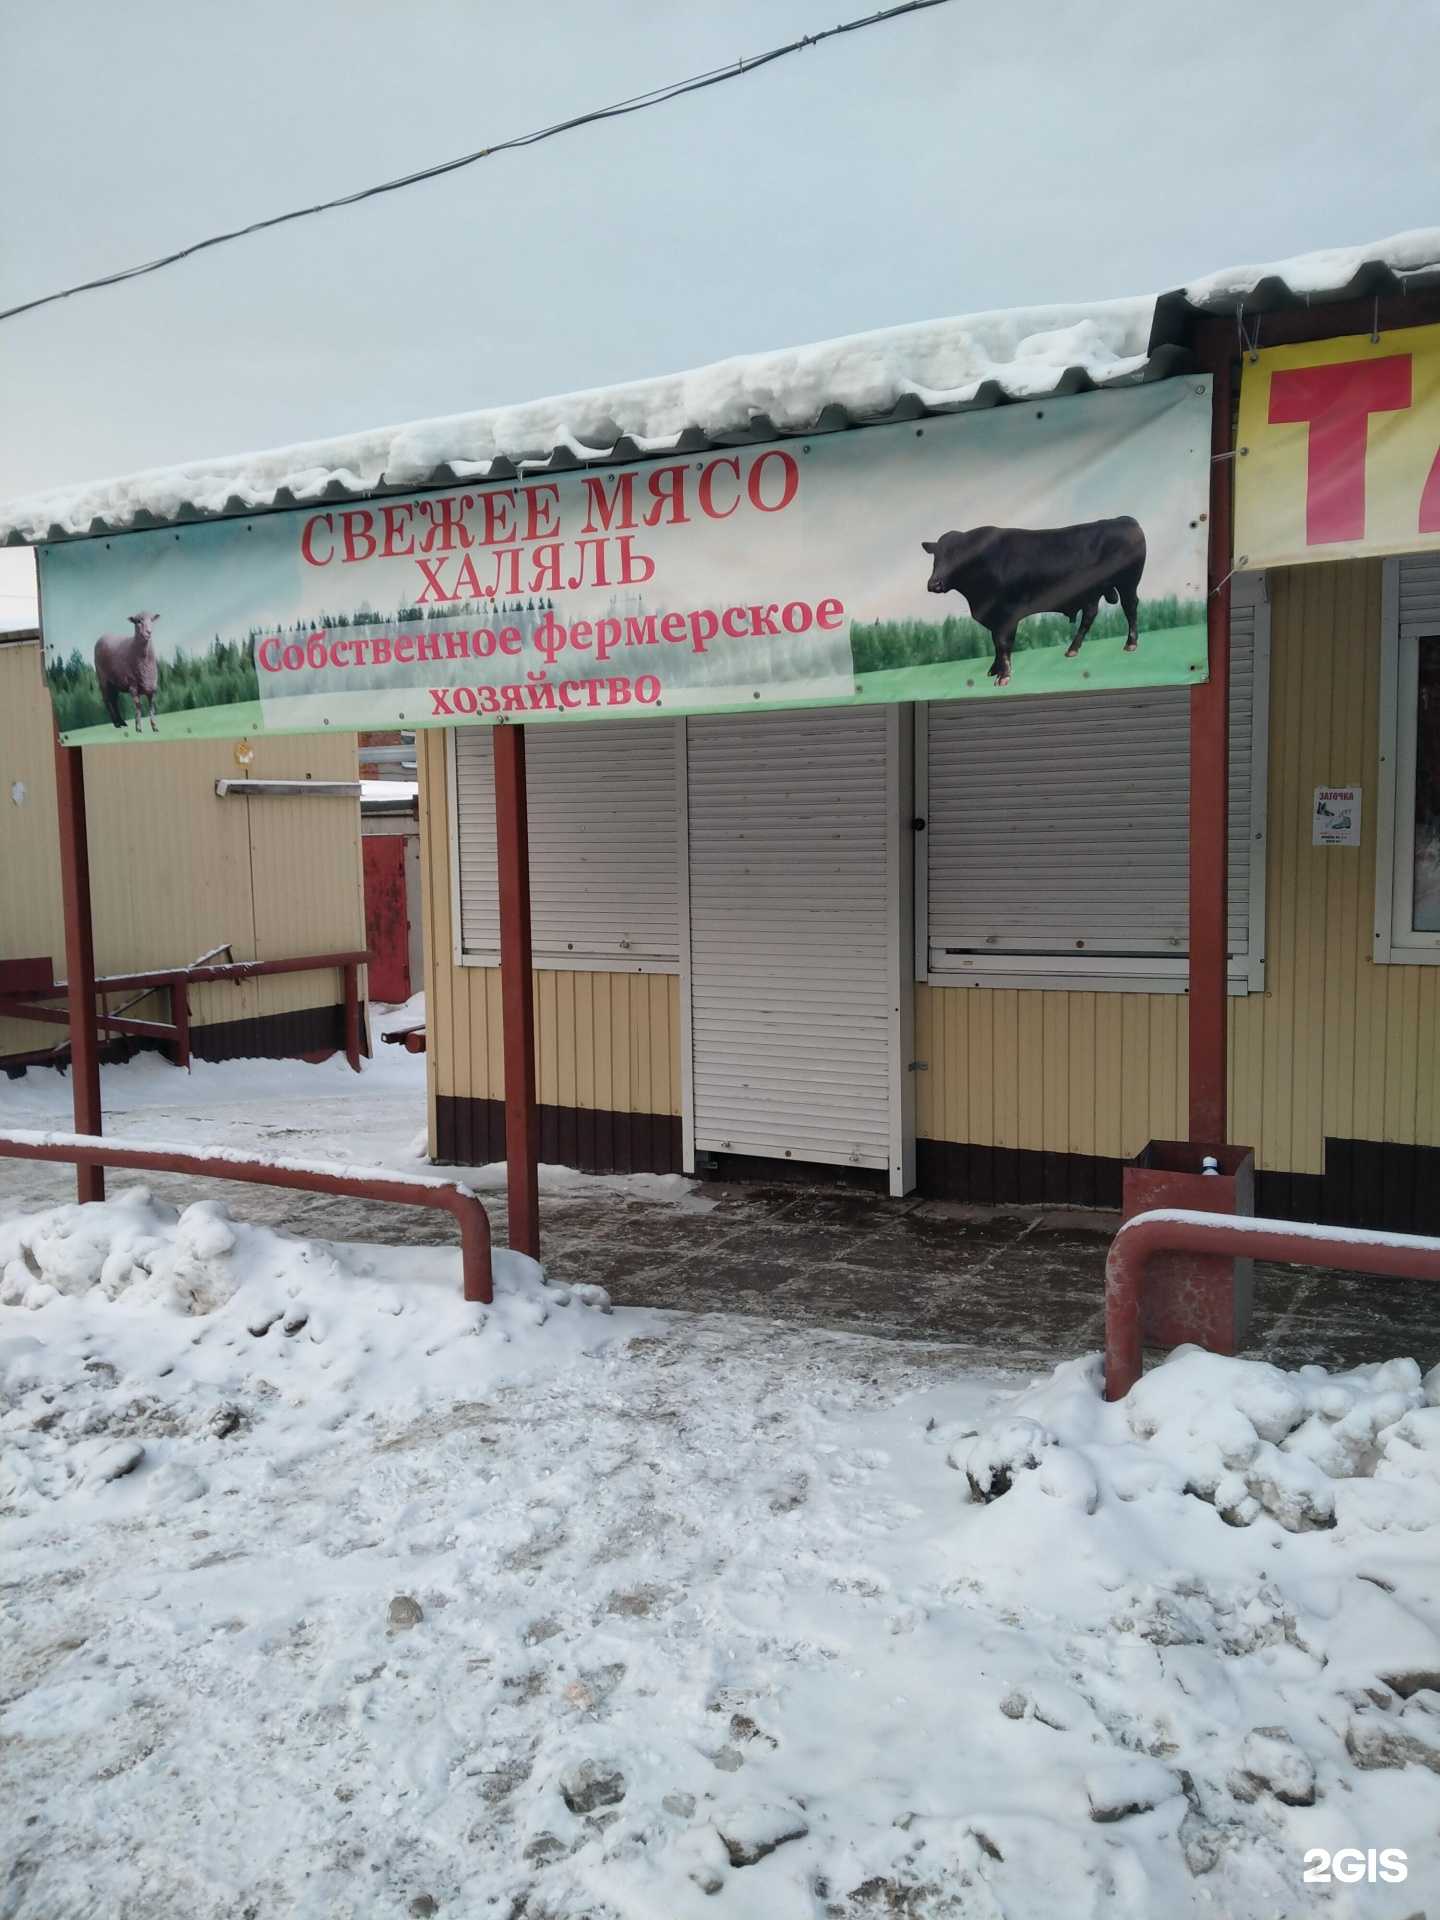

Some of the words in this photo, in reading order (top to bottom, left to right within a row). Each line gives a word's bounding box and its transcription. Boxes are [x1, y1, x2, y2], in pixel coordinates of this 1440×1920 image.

[1268, 352, 1440, 546] Т
[301, 483, 561, 567] СВЕЖЕЕ
[581, 449, 800, 535] МЯСО
[416, 533, 656, 604] ХАЛЯЛЬ
[258, 622, 523, 673] Собственное
[533, 598, 846, 664] фермерское
[430, 671, 662, 716] хозяйство
